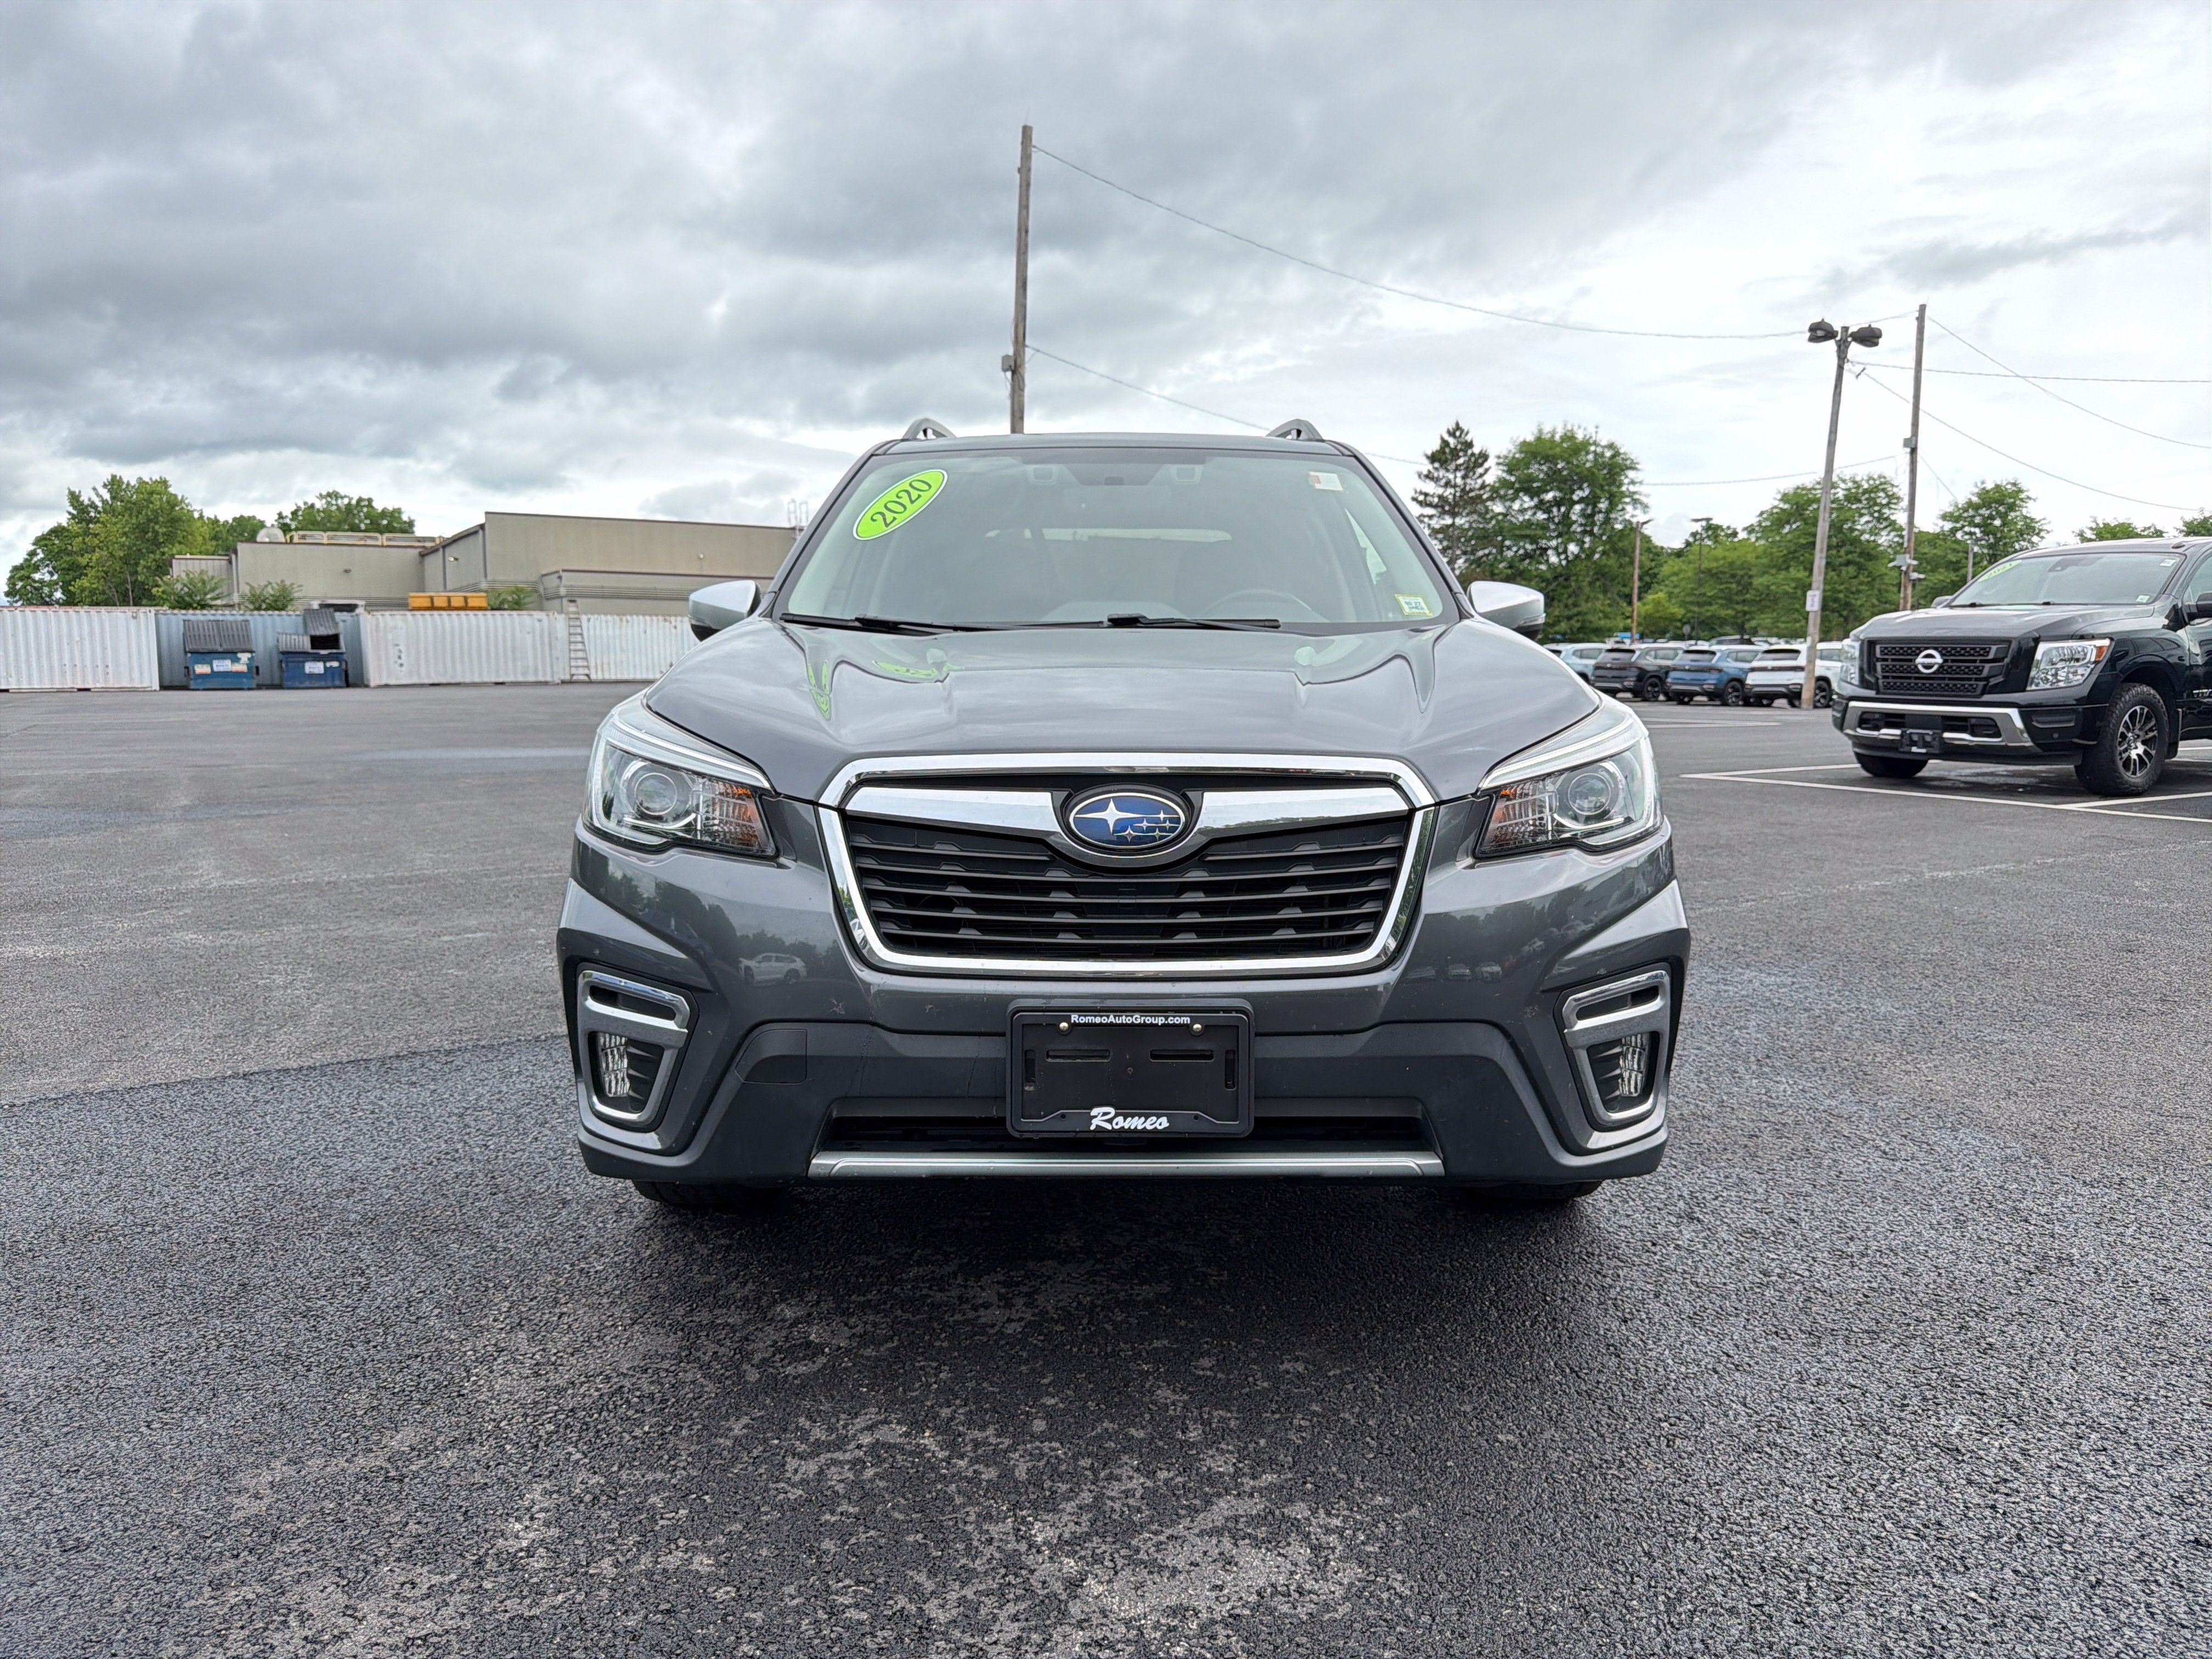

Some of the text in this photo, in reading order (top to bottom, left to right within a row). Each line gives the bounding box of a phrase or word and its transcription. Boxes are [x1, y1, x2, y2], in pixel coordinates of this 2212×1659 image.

[870, 479, 932, 528] 2020
[1071, 1014, 1190, 1025] RomeoAutoGroup.com
[1090, 1107, 1170, 1130] Romeo
